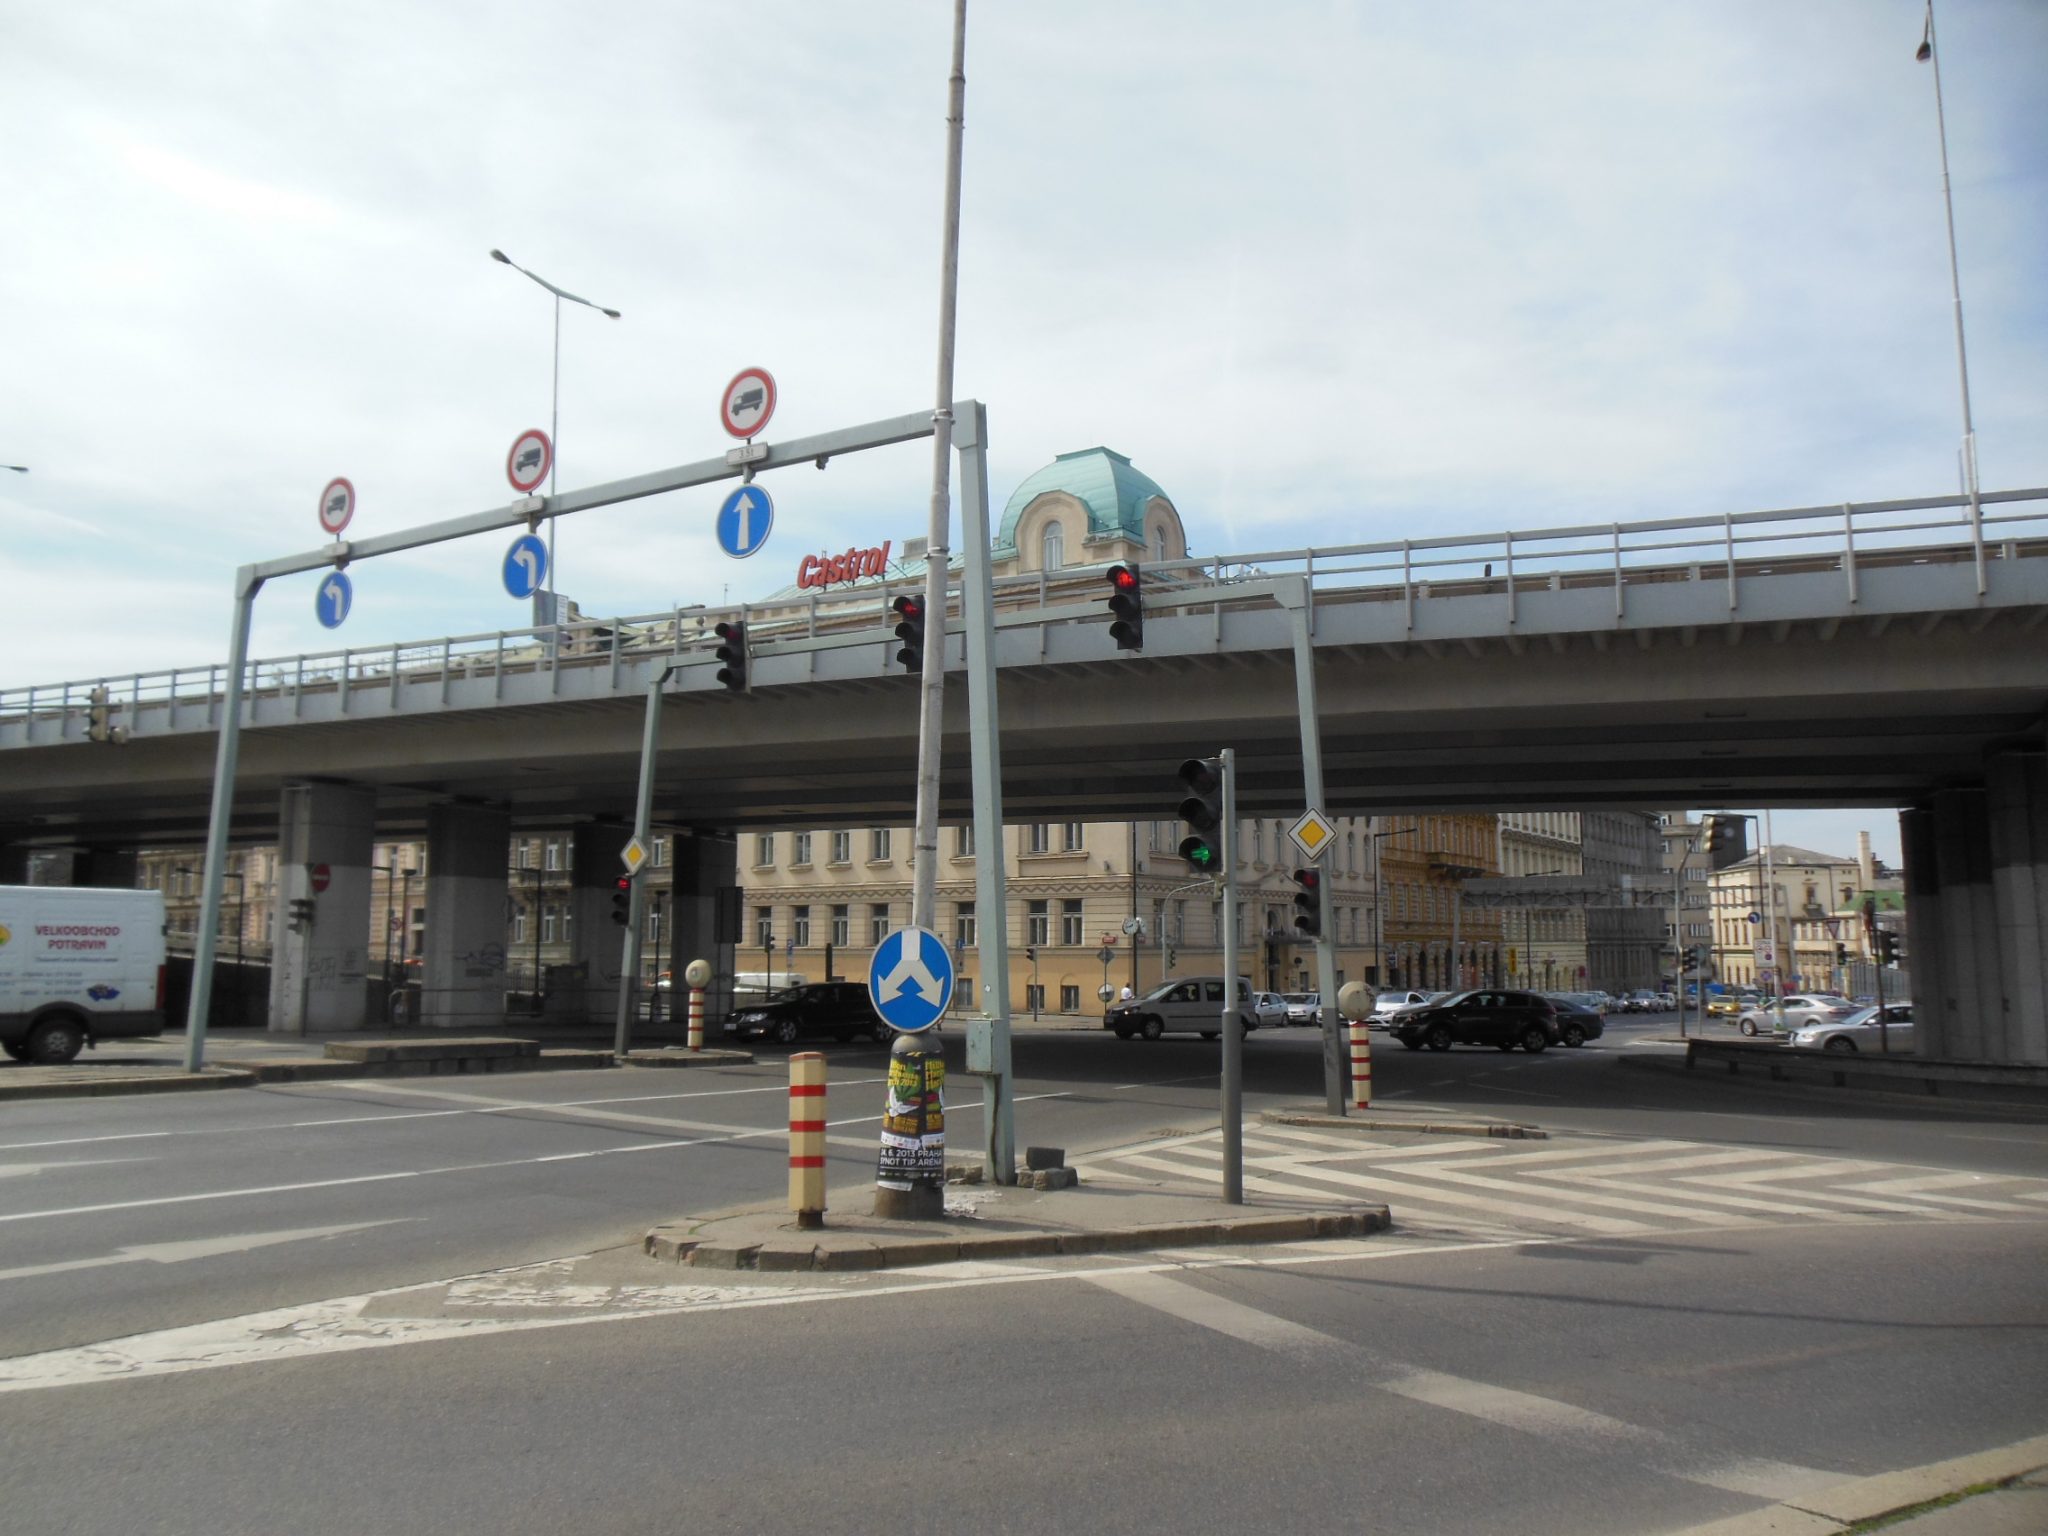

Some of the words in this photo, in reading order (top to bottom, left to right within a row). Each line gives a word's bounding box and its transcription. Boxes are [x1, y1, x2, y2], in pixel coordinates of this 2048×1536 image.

[797, 540, 891, 589] Castrol
[35, 925, 121, 936] VELKOOBCHOD
[48, 939, 107, 950] POTRAVIN
[896, 1149, 915, 1158] 2013
[902, 1158, 916, 1166] TIP
